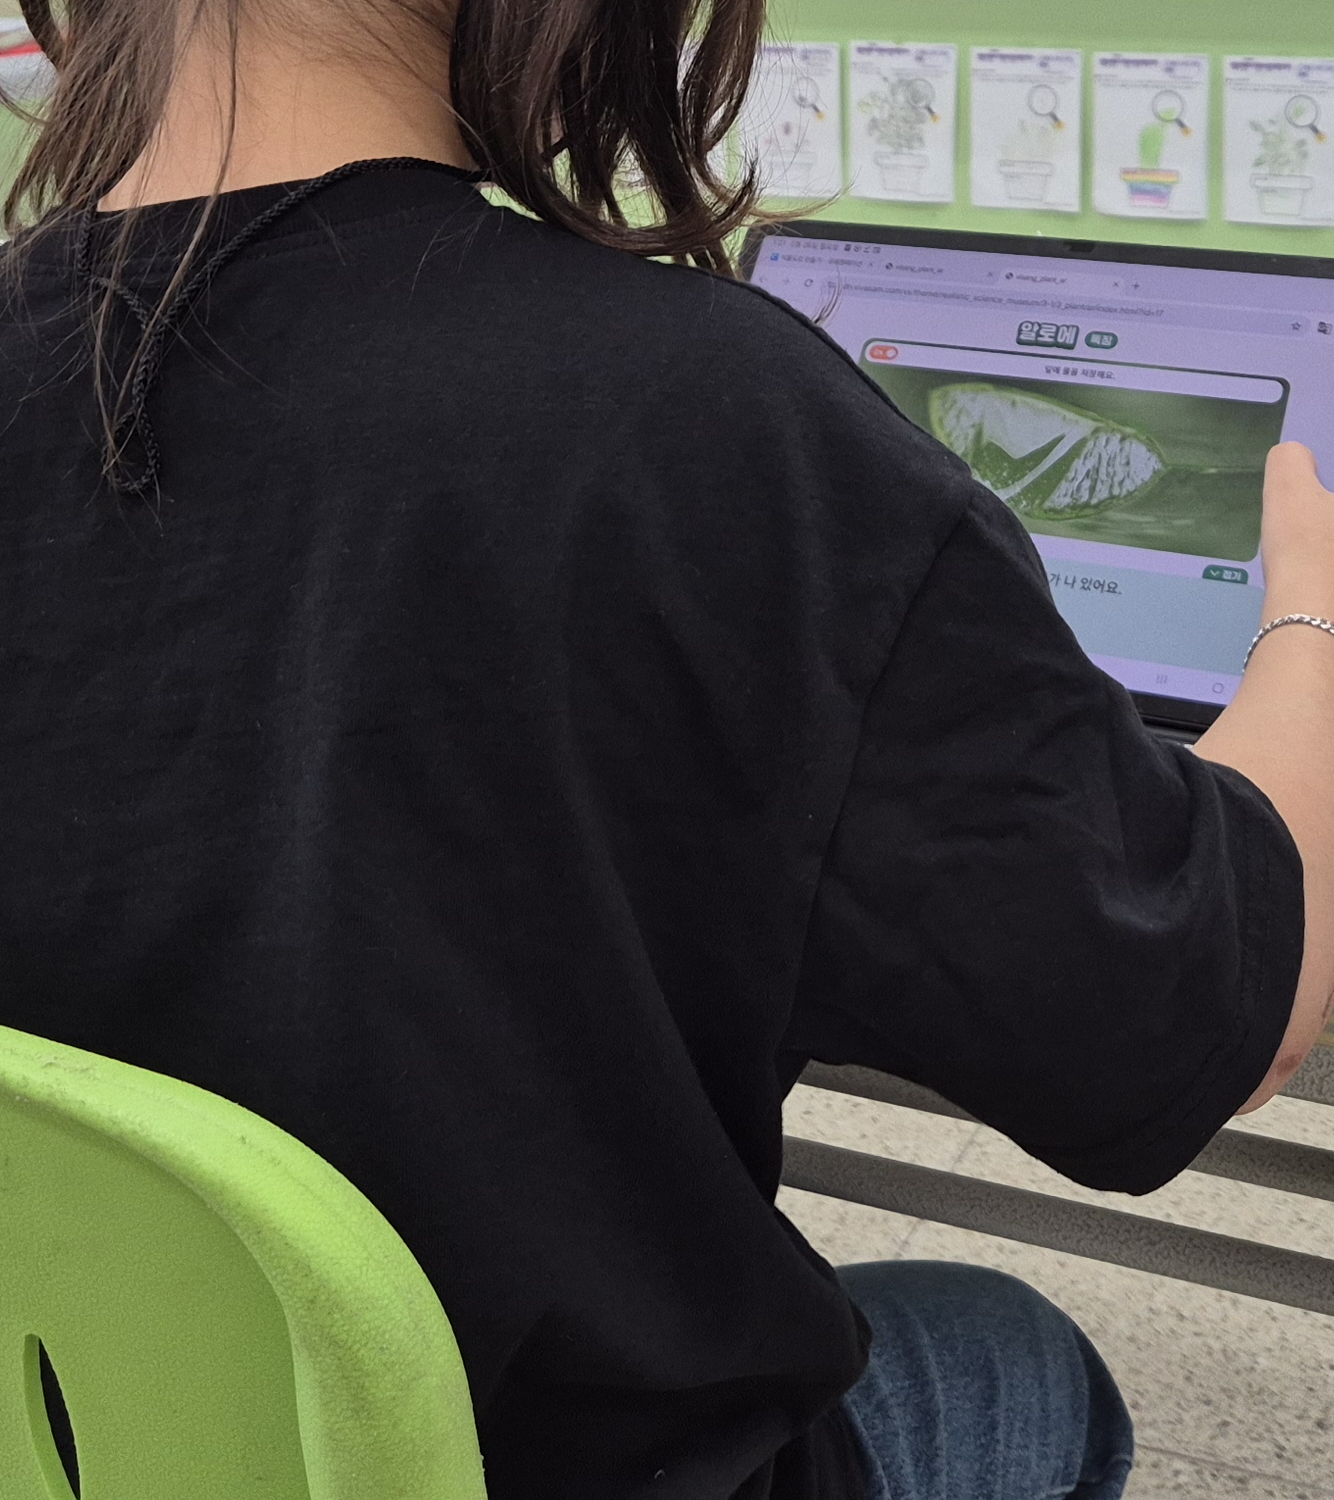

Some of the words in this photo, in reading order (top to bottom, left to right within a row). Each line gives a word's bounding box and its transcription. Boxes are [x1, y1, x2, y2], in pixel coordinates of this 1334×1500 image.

[1018, 321, 1078, 349] 알로에
[1064, 574, 1078, 590] 나
[1080, 576, 1123, 596] 있어요.
